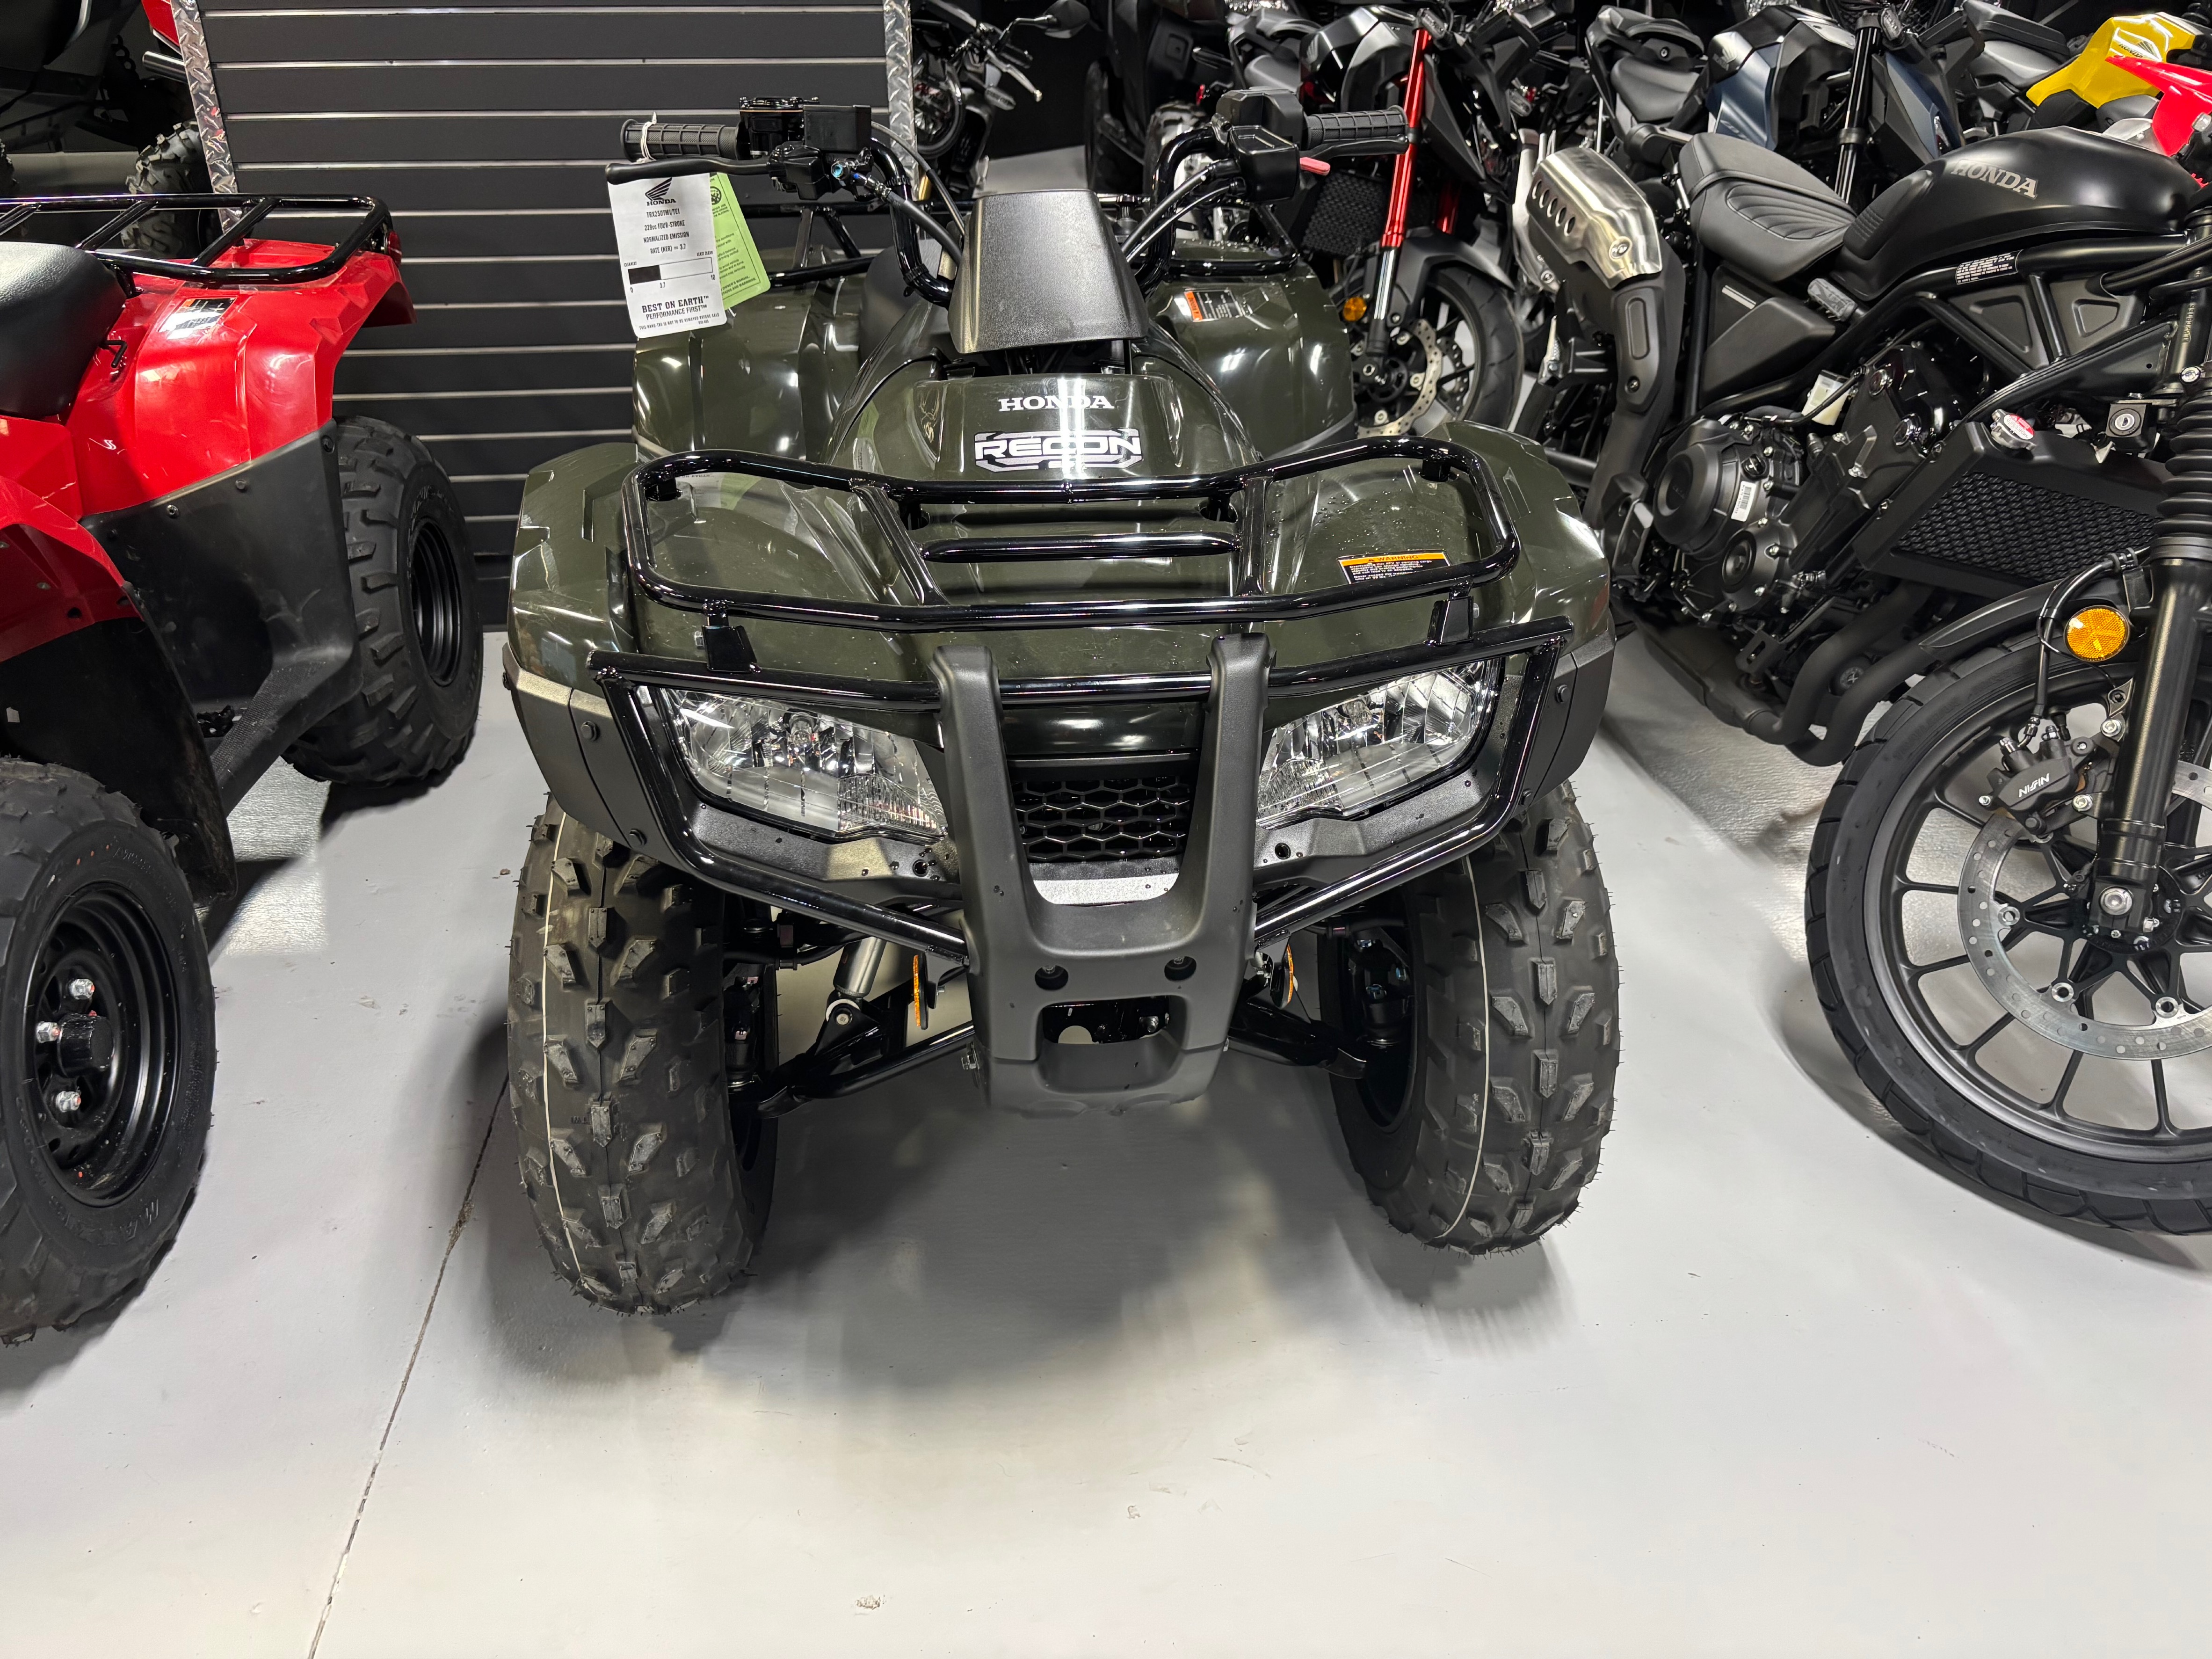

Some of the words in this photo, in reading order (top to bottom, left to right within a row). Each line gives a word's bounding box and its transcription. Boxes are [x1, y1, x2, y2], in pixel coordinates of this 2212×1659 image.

[1950, 159, 2037, 198] HONDA
[658, 220, 685, 229] FOUR-STROKE
[643, 234, 669, 243] NORMALIZED
[642, 303, 662, 313] BEST
[665, 300, 675, 309] ON
[646, 308, 685, 320] PERFORMANCE
[998, 396, 1115, 412] HONDA
[975, 436, 1142, 459] RECON
[2018, 773, 2050, 798] NISSIN
